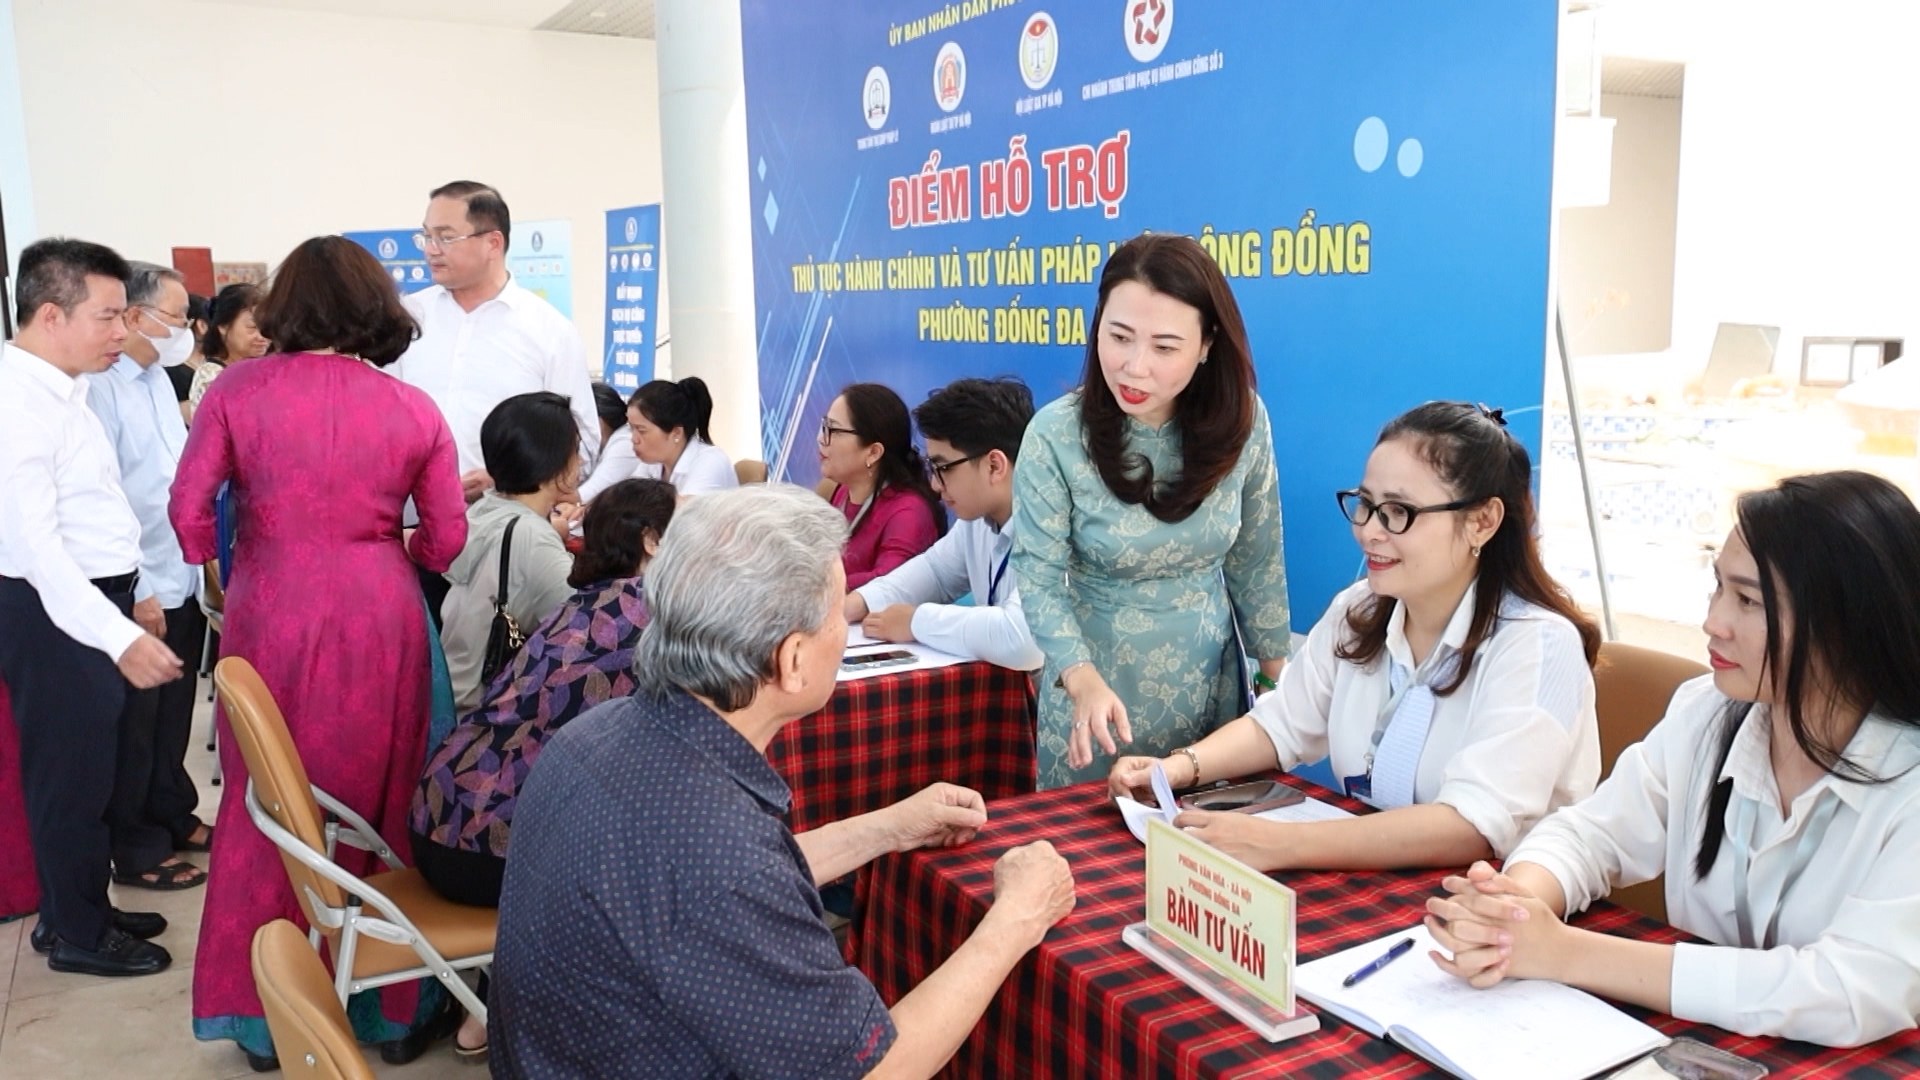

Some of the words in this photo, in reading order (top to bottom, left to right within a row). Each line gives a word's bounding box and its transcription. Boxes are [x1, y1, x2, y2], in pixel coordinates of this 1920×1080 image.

[904, 18, 926, 42] BAN
[928, 4, 961, 33] NHÂN
[889, 149, 970, 230] ĐIỂM
[980, 134, 1032, 219] HỖ
[1042, 130, 1130, 219] TRỢ
[792, 254, 815, 293] THỦ
[817, 262, 842, 298] TỤC
[845, 254, 883, 292] HÀNH
[887, 250, 935, 290] CHÍNH
[940, 246, 963, 288] VÀ
[966, 247, 992, 287] TƯ
[994, 236, 1035, 286] VẤN
[1041, 235, 1101, 285] PHÁP
[919, 300, 989, 343] PHƯỜNG
[994, 294, 1050, 345] ĐỐNG
[1056, 307, 1088, 345] ĐA
[1167, 886, 1199, 939] BÀN
[1204, 909, 1226, 953] TƯ
[1230, 922, 1265, 981] VẤN
